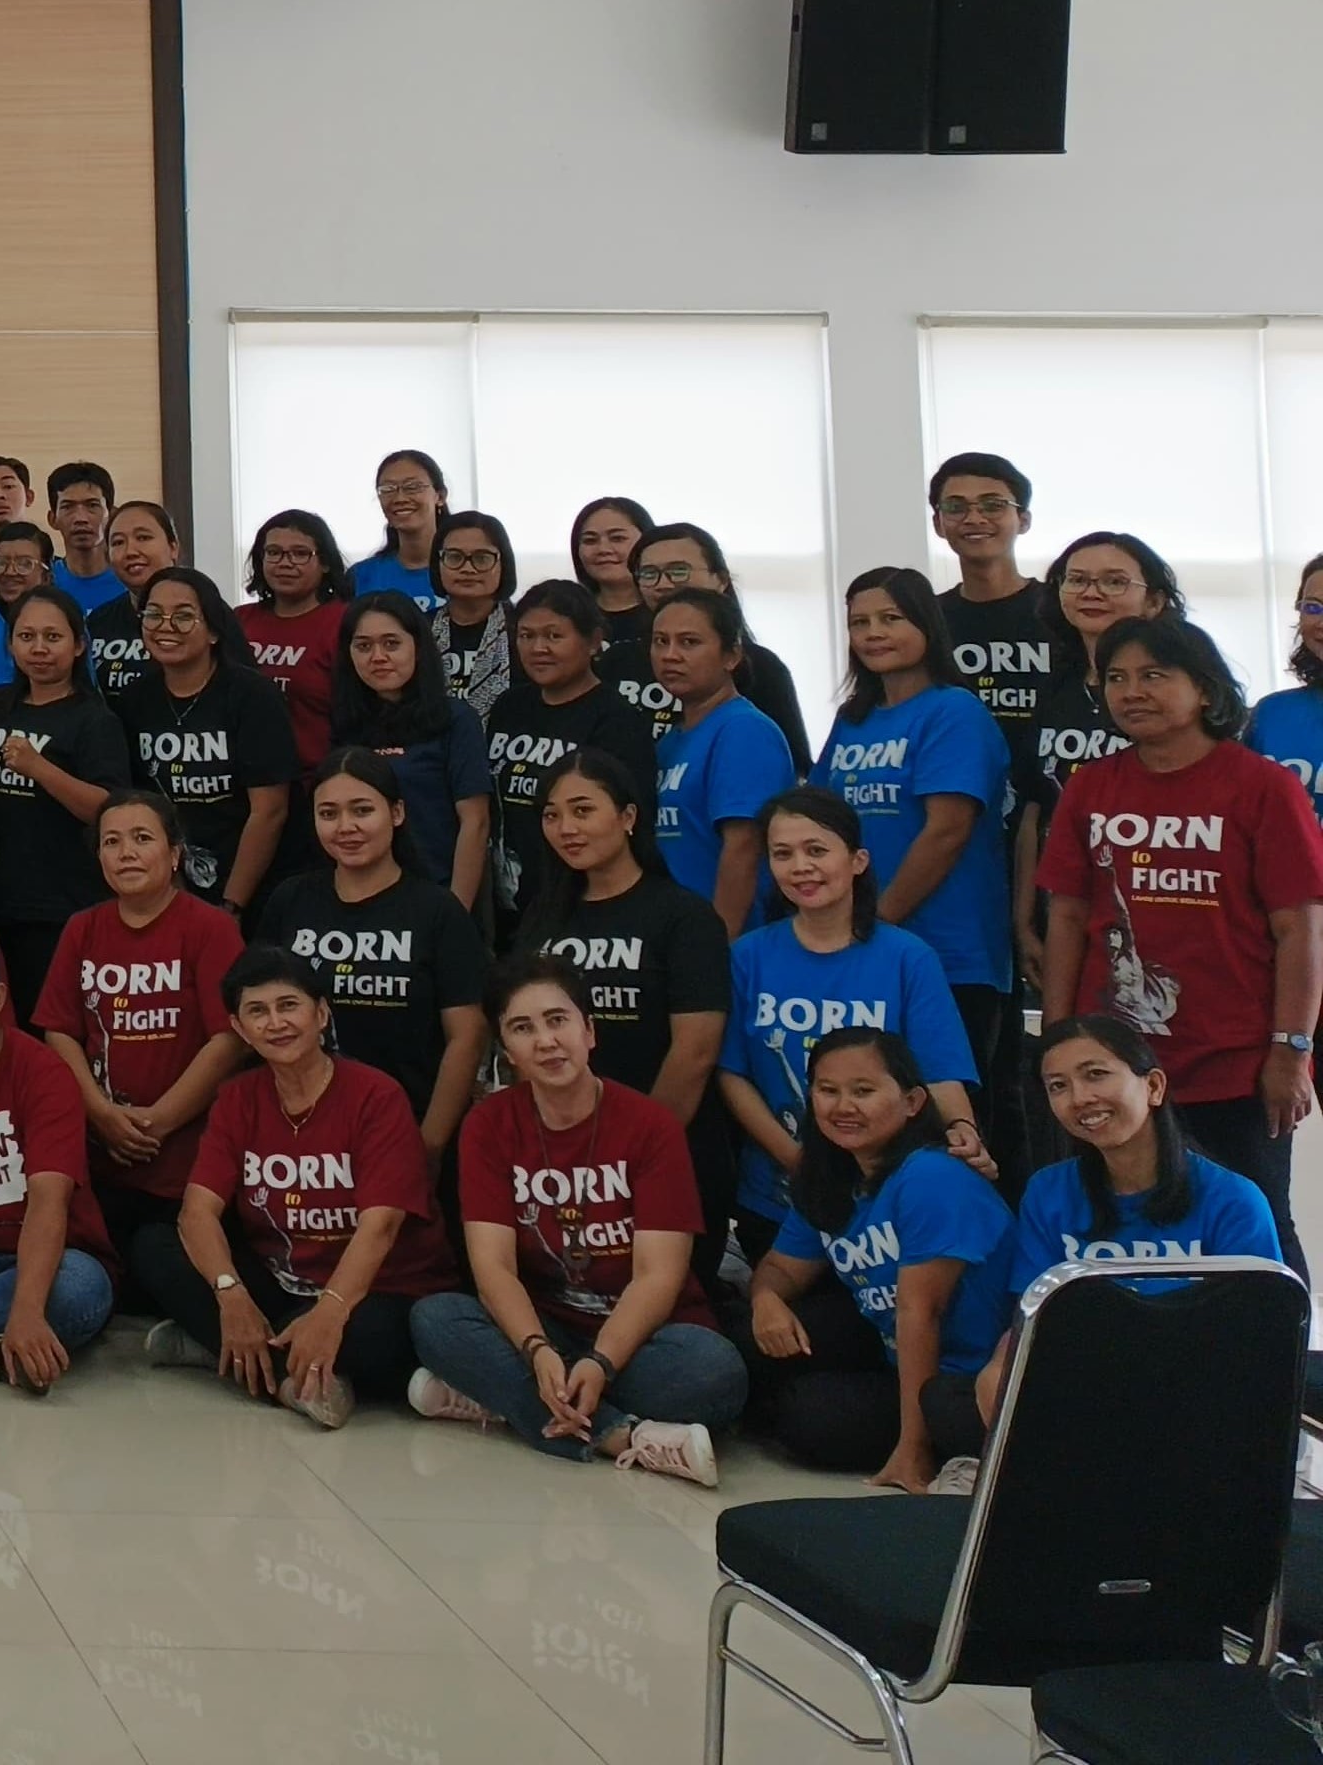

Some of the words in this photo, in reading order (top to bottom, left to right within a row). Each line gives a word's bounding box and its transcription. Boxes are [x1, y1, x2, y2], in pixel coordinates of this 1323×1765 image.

[91, 638, 151, 661] BOR
[953, 641, 1051, 674] ORN
[110, 661, 123, 671] to
[108, 671, 142, 689] FIG
[978, 675, 995, 687] to
[978, 688, 1037, 708] FIGH
[139, 730, 229, 763] BORN
[489, 732, 578, 768] BORN
[831, 738, 909, 771] BORN
[170, 763, 184, 774] to
[512, 763, 526, 774] to
[172, 774, 232, 796] FIGHT
[508, 776, 538, 797] FIG
[844, 783, 902, 804] FIGHT
[1089, 812, 1225, 852] BORN
[1131, 850, 1152, 865] to
[1131, 867, 1222, 894] FIGHT
[290, 928, 412, 963] BORN
[540, 937, 644, 971] ORN
[81, 959, 182, 996] BORN
[335, 963, 353, 974] to
[333, 974, 411, 997] FIGHT
[113, 996, 129, 1008] to
[592, 986, 641, 1010] GHT
[112, 1007, 181, 1032] FIGHT
[755, 992, 887, 1035] BORN
[243, 1150, 355, 1190] BORN
[513, 1160, 633, 1206] BORN
[284, 1191, 301, 1206] to
[286, 1206, 357, 1231] FIGHT
